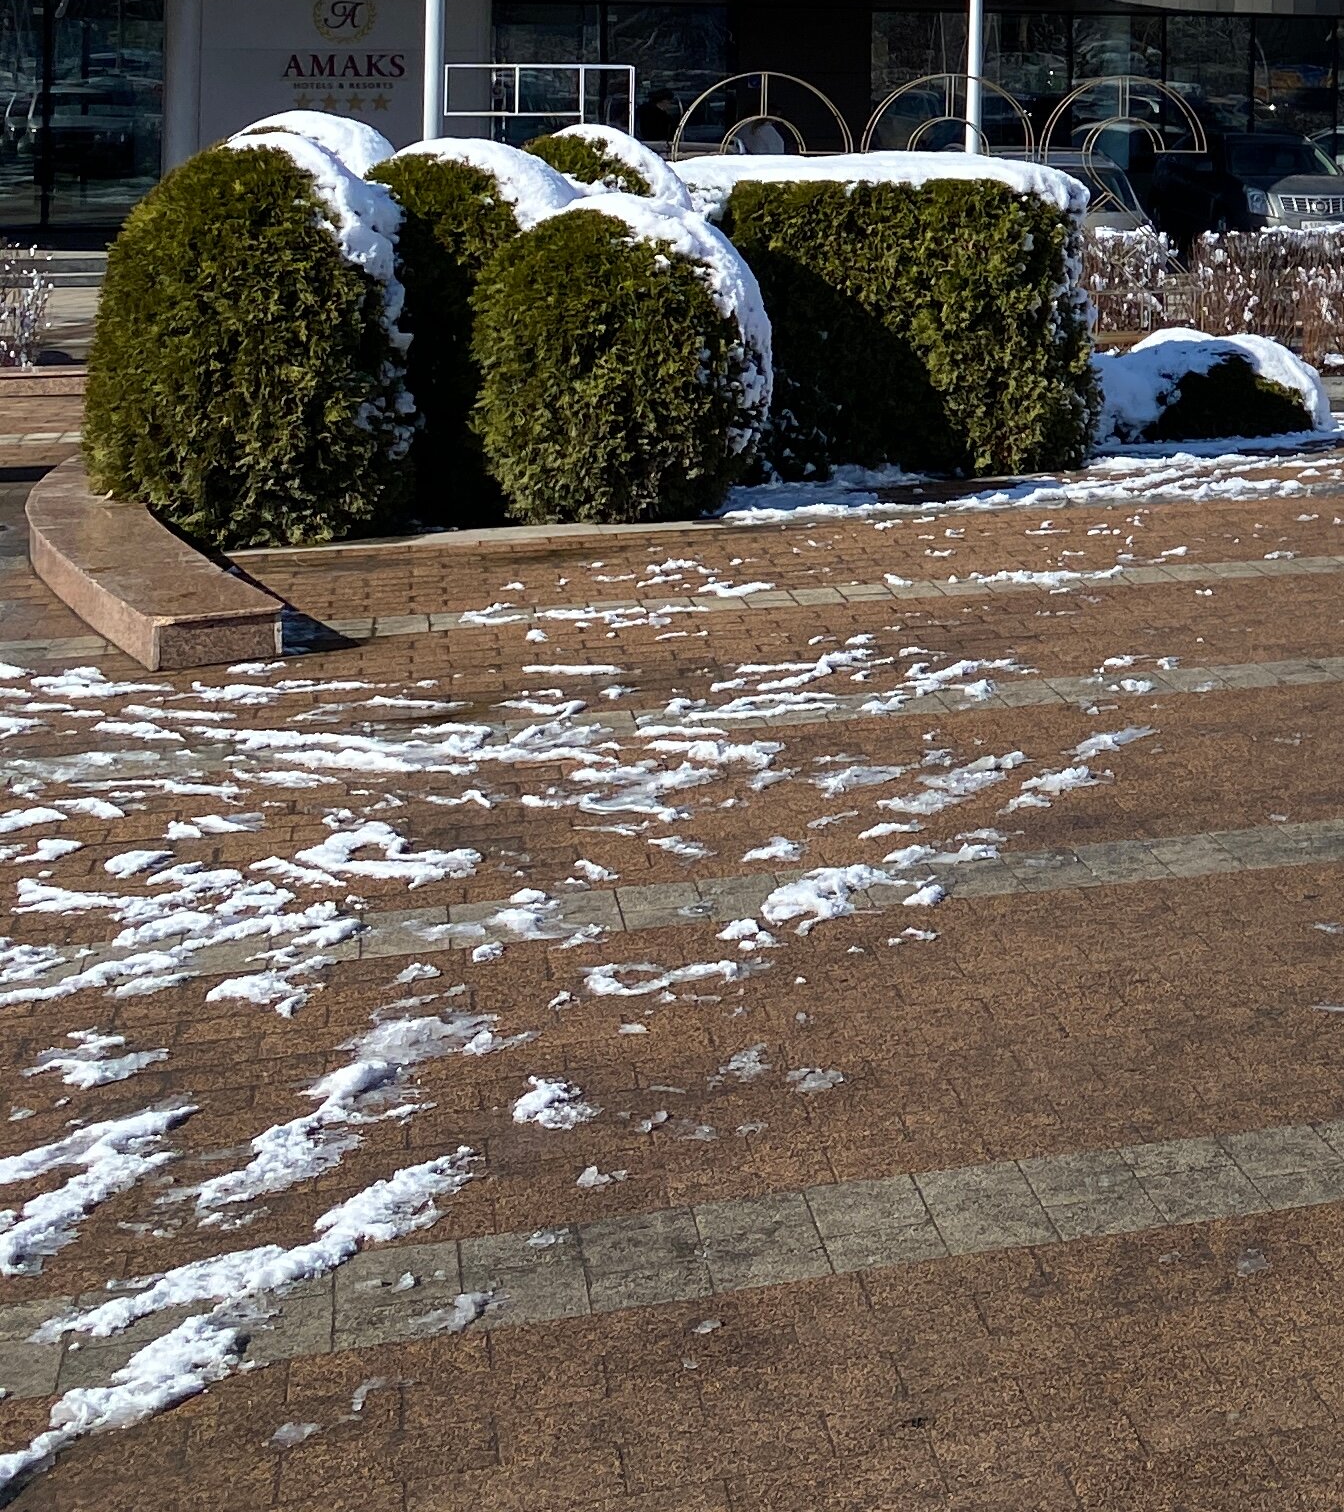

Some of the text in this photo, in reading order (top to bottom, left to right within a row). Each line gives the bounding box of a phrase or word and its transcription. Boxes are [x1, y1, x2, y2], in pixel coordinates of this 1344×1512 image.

[282, 53, 406, 78] AMAKS
[293, 81, 394, 90] HOTELS & RESORTS
